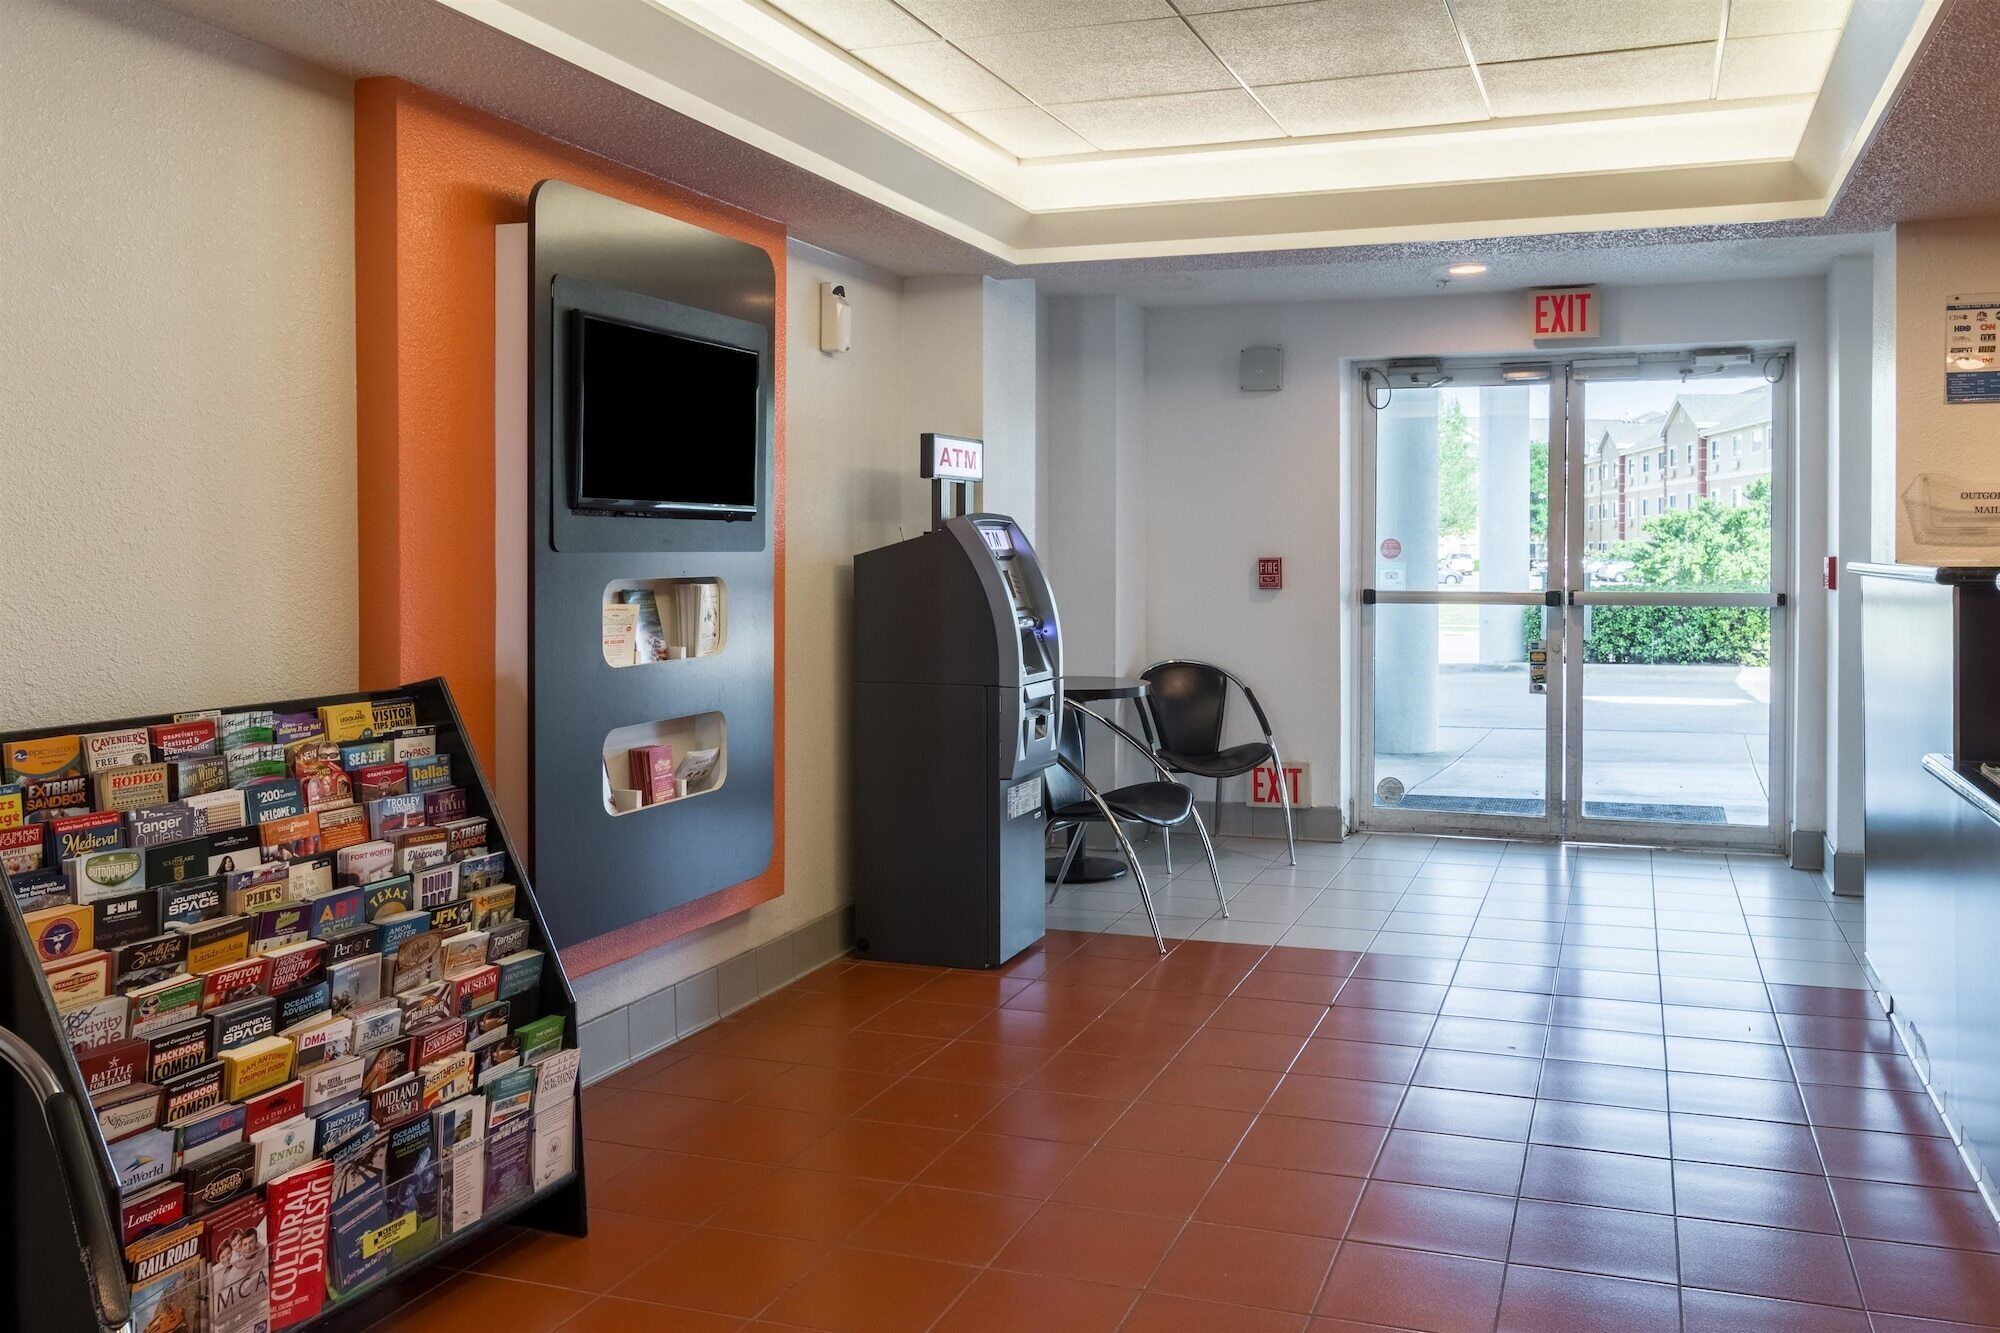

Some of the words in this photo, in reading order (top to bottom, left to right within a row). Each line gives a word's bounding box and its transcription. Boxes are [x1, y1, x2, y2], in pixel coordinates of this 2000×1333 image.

[1535, 293, 1591, 334] EXIT
[1954, 325, 1972, 333] HBO
[1980, 323, 1996, 331] CNN
[939, 447, 977, 470] ATM
[1260, 562, 1278, 574] FIRE
[339, 715, 366, 723] LEGOLAND
[372, 707, 412, 722] VISITOR
[373, 721, 388, 732] TIPS
[390, 718, 414, 730] ONLINE
[91, 732, 147, 753] CAVENDER'S
[163, 737, 193, 748] Festival
[193, 736, 200, 744] &
[163, 747, 186, 757] Event
[187, 743, 210, 753] Guide
[95, 757, 119, 767] FREE
[399, 747, 431, 759] CityPASS
[112, 772, 163, 788] RODEO
[197, 763, 218, 782] Wine
[218, 768, 225, 777] &
[203, 775, 225, 789] DINE
[413, 765, 449, 781] Dallas
[28, 778, 86, 799] EXTREME
[418, 779, 432, 787] FORT
[26, 792, 86, 811] SANDBOX
[257, 789, 280, 804] $200
[386, 796, 421, 808] TROLLEY
[260, 807, 291, 822] WELCOME
[392, 804, 416, 814] TOURS
[134, 816, 183, 837] Tanger
[451, 823, 487, 841] EXTREME
[0, 838, 17, 847] FOR
[19, 833, 40, 845] FUN!
[62, 829, 119, 857] Medieval
[135, 829, 184, 848] Outlets
[450, 835, 487, 850] SANDBOX
[2, 848, 27, 856] BUFFET!
[350, 851, 368, 862] FORT
[369, 847, 393, 858] WORTH
[407, 848, 444, 862] Discover
[88, 862, 139, 878] OUTDOORABLE
[30, 888, 47, 898] Being
[46, 884, 66, 894] Printed
[31, 882, 58, 891] America's
[421, 870, 453, 894] ROUND
[168, 896, 219, 916] SPACE
[170, 889, 213, 905] JOURNEY
[245, 887, 282, 908] PINK'S
[369, 887, 408, 908] TEXAS
[319, 897, 360, 923] ART
[431, 905, 458, 926] JFK
[115, 926, 150, 939] SHOWING
[386, 929, 417, 944] CARTER
[388, 923, 413, 936] AMON
[493, 929, 526, 947] Tanger
[194, 949, 219, 964] Lands
[226, 940, 244, 954] Asia
[491, 941, 522, 958] Outlets
[217, 964, 263, 984] DENTON
[274, 959, 312, 977] COUNTRY
[223, 976, 262, 990] TEXAS
[271, 971, 298, 987] TOURS
[460, 971, 497, 997] MUSEUM
[282, 998, 325, 1018] ADVENTURE
[283, 993, 314, 1010] OCEANS
[314, 989, 324, 999] OF
[68, 1014, 123, 1040] Activity
[222, 1020, 273, 1045] SPACE
[225, 1015, 266, 1033] JOURNEY
[362, 1024, 394, 1042] RANCH
[170, 1034, 191, 1045] Comedy
[303, 1032, 326, 1048] DMA
[154, 1040, 206, 1064] BACKDOOR
[153, 1050, 206, 1081] COMEDY
[240, 1062, 257, 1074] SAN
[258, 1052, 289, 1068] ANTONIO
[90, 1079, 106, 1091] FOR
[106, 1072, 133, 1087] TEXAS
[91, 1063, 133, 1083] BATTLE
[185, 1076, 206, 1088] Comedy
[239, 1072, 264, 1084] COUPON
[264, 1063, 286, 1077] BOOK
[544, 1068, 577, 1088] MACHINES
[550, 1074, 576, 1089] MOTION
[169, 1082, 219, 1108] BACKDOOR
[376, 1081, 419, 1110] MIDLAND
[168, 1091, 219, 1121] COMEDY
[254, 1103, 297, 1125] CALDWELL
[387, 1100, 409, 1115] TEXAS
[101, 1114, 122, 1128] New
[113, 1111, 154, 1130] Braunfels
[326, 1108, 365, 1131] FRONTIER
[392, 1123, 419, 1139] OCEANS
[420, 1118, 430, 1128] OF
[333, 1140, 361, 1161] OCEANS
[361, 1132, 371, 1143] OF
[391, 1127, 431, 1148] ADVENTURE
[268, 1140, 305, 1167] ENNIS
[205, 1171, 241, 1192] Caverns
[209, 1178, 242, 1200] Sonora
[127, 1200, 177, 1229] Longview
[298, 1175, 331, 1276] DISTRICT
[159, 1241, 178, 1252] GORGE
[179, 1231, 198, 1243] ROUTE
[270, 1182, 313, 1301] CULTURAL
[137, 1237, 199, 1282] RAILROAD
[216, 1270, 268, 1313] MCA
